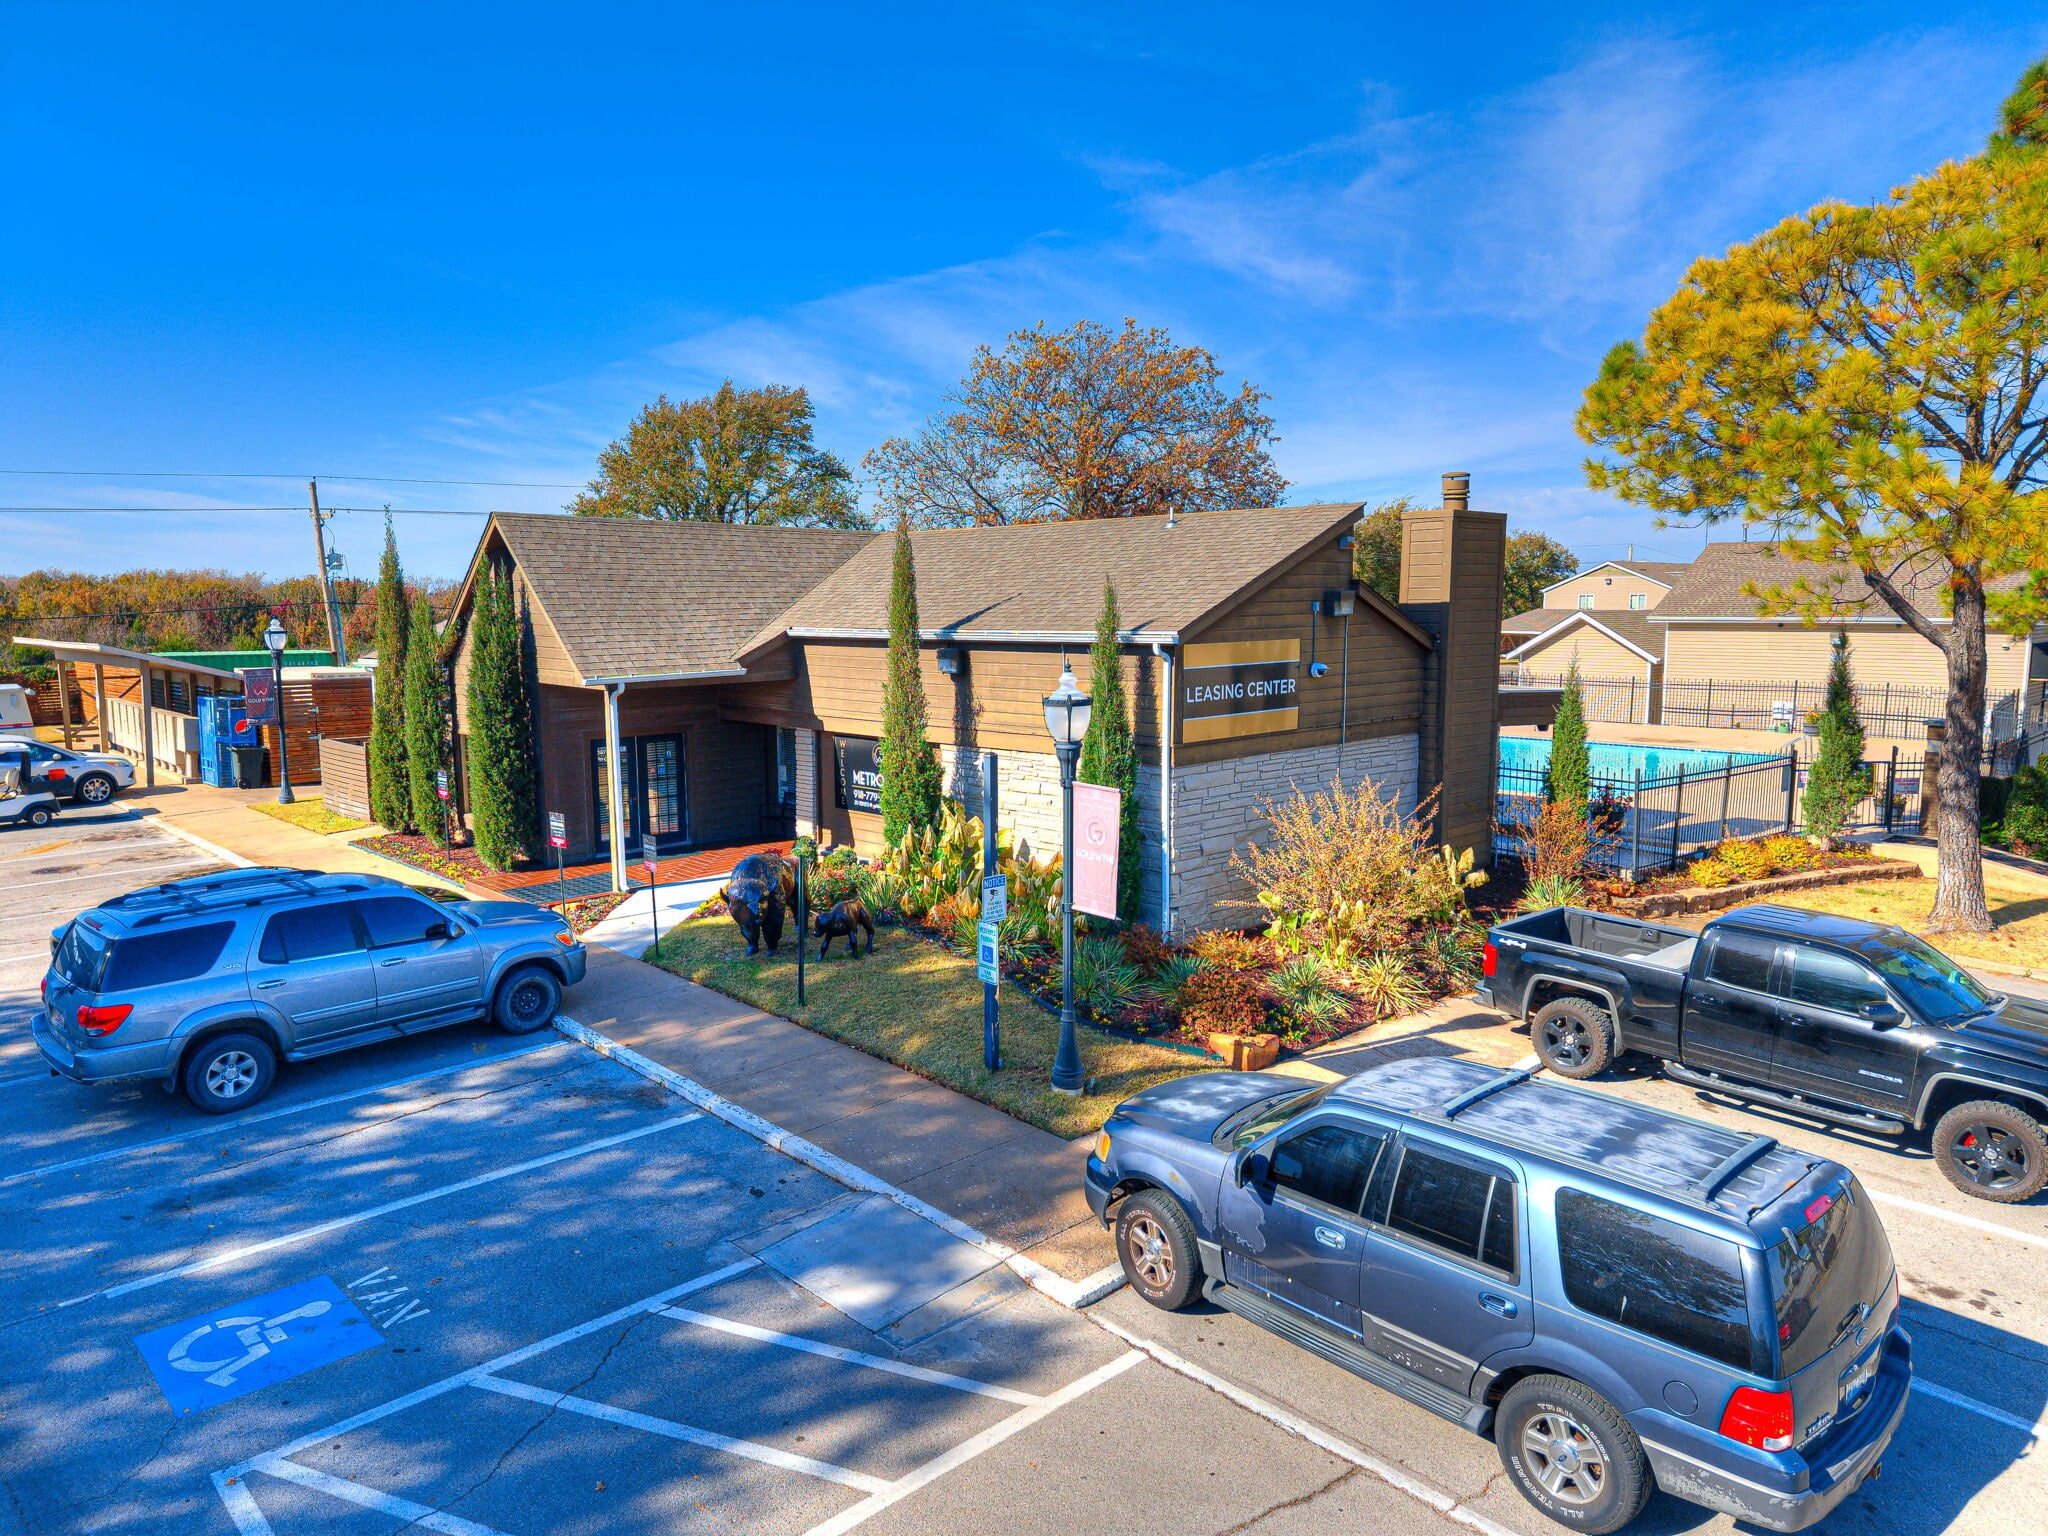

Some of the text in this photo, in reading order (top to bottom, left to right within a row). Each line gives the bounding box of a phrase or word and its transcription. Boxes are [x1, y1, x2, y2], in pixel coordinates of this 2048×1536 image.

[1186, 678, 1296, 703] LEASING CENTER
[852, 769, 885, 788] METRO
[984, 876, 1006, 889] NOTICE
[346, 1265, 431, 1329] VAN
[1537, 1403, 1611, 1463] TRAIL GUIDE
[1511, 1456, 1585, 1520] ALL TERRAIN
